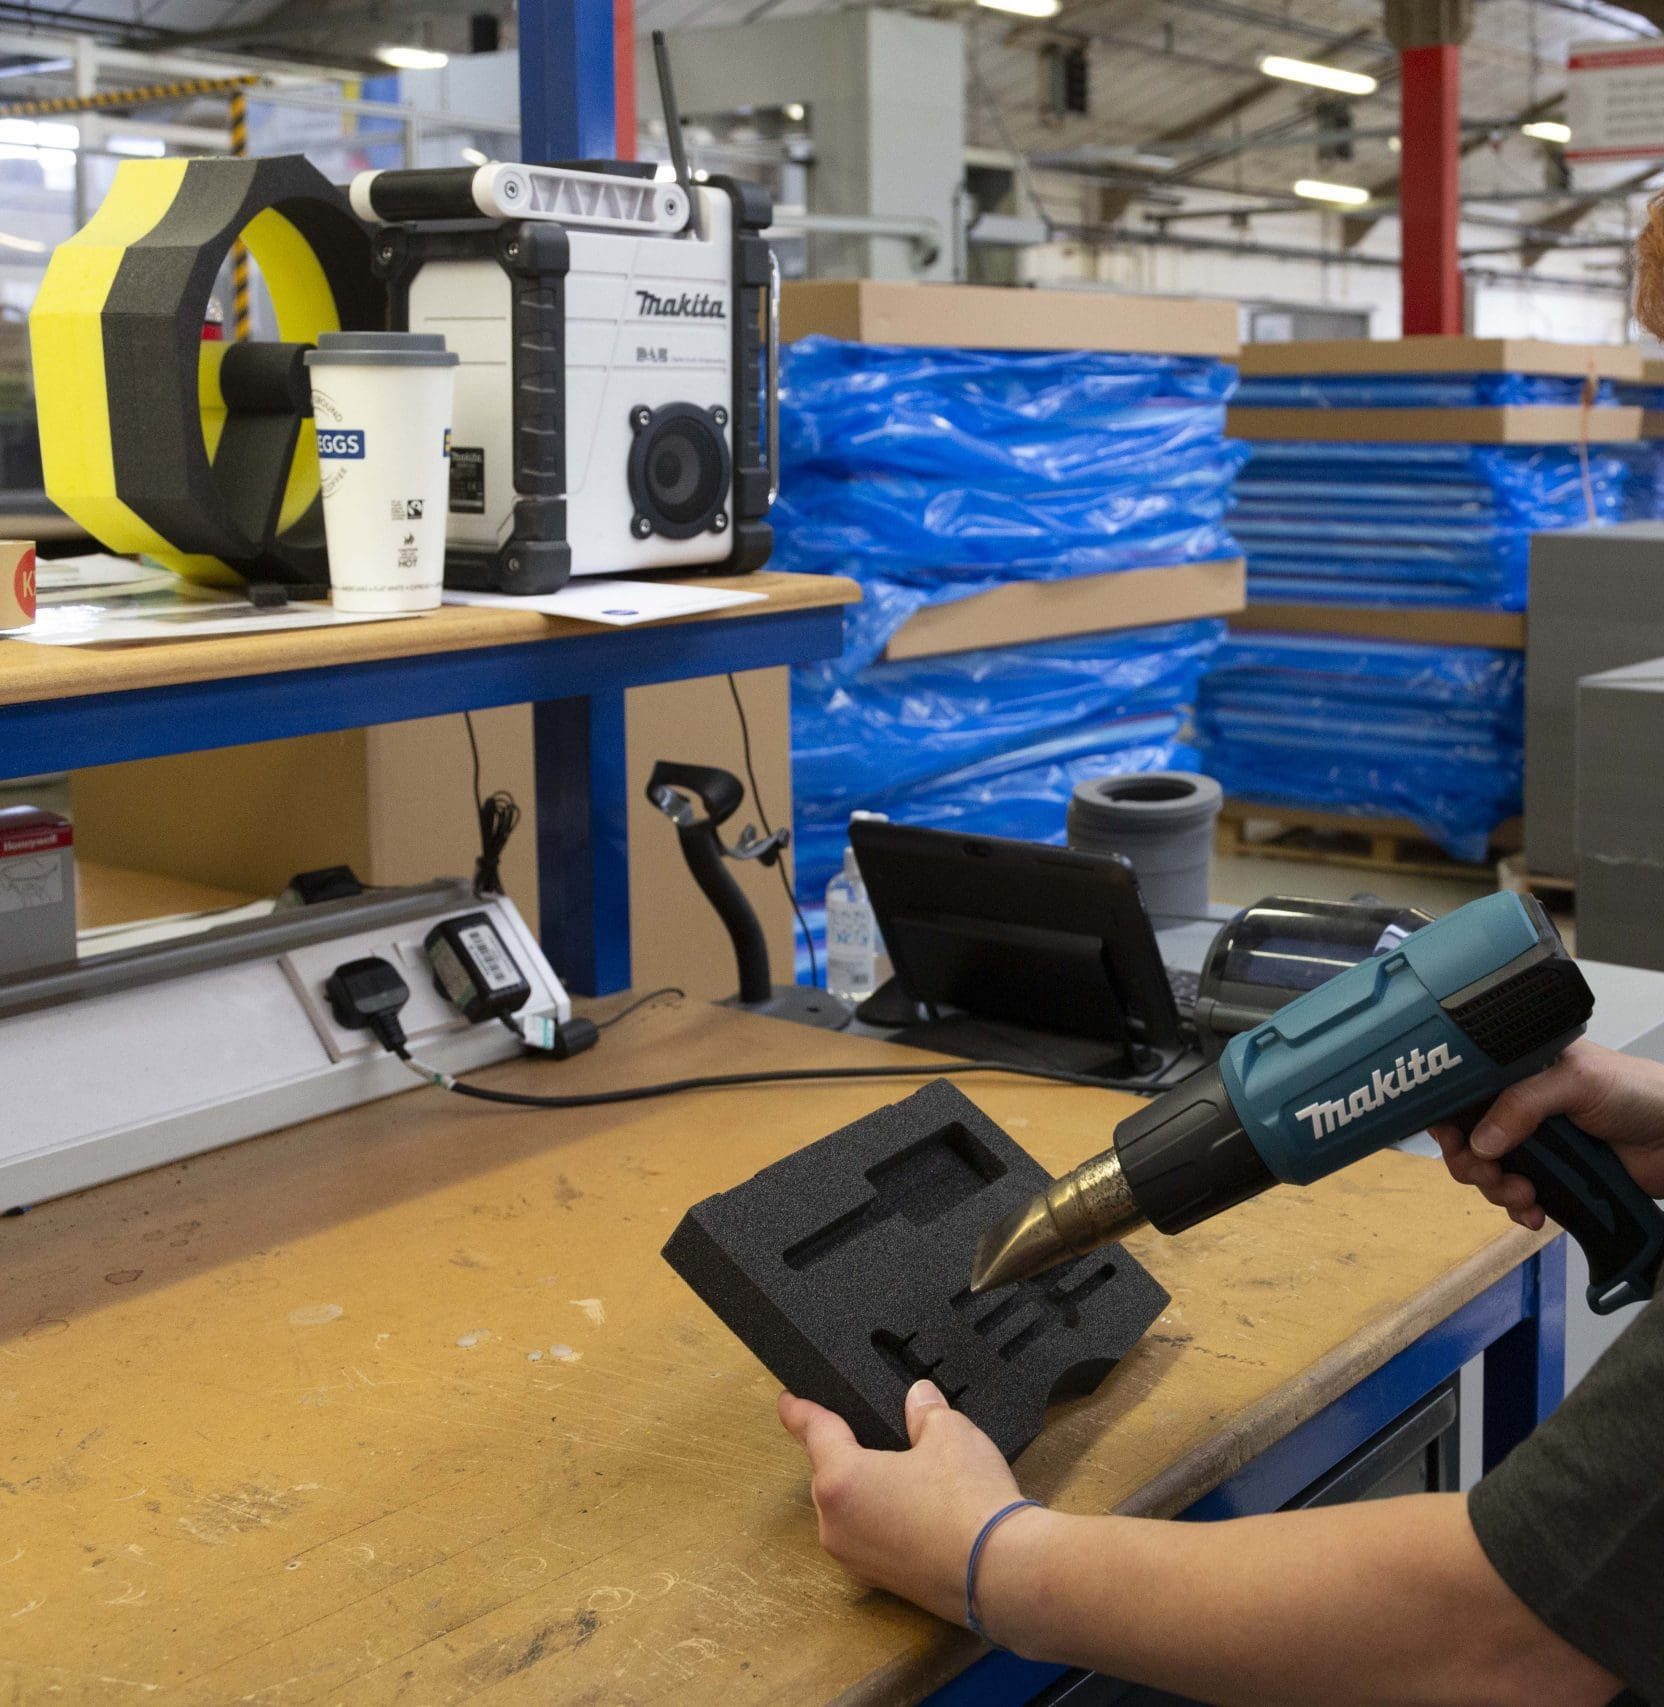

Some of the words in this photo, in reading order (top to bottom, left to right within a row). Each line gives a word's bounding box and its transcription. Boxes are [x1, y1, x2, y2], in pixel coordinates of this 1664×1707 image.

[635, 290, 726, 318] Makita
[398, 559, 418, 568] HOT
[3, 833, 58, 851] Honeywell
[1294, 1042, 1464, 1139] Makita
